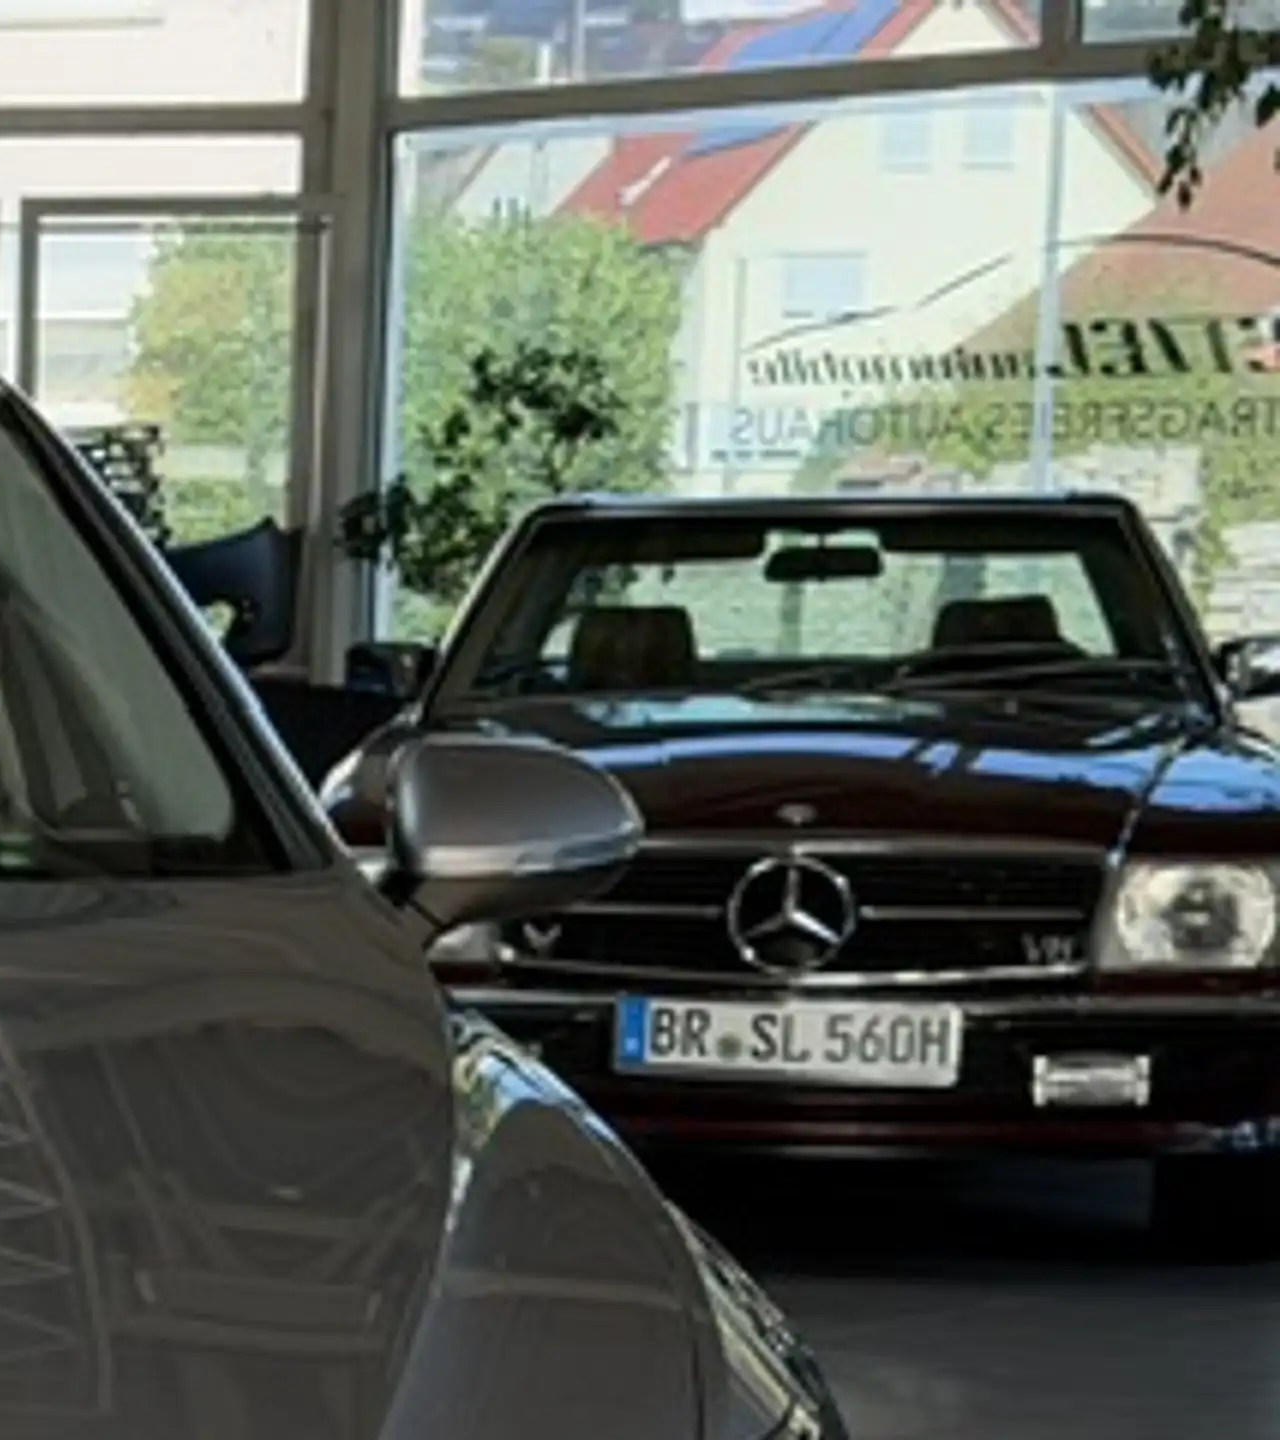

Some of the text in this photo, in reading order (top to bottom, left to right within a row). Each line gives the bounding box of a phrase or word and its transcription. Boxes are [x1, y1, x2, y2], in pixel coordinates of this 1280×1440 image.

[650, 1007, 951, 1066] BR SL 560H
